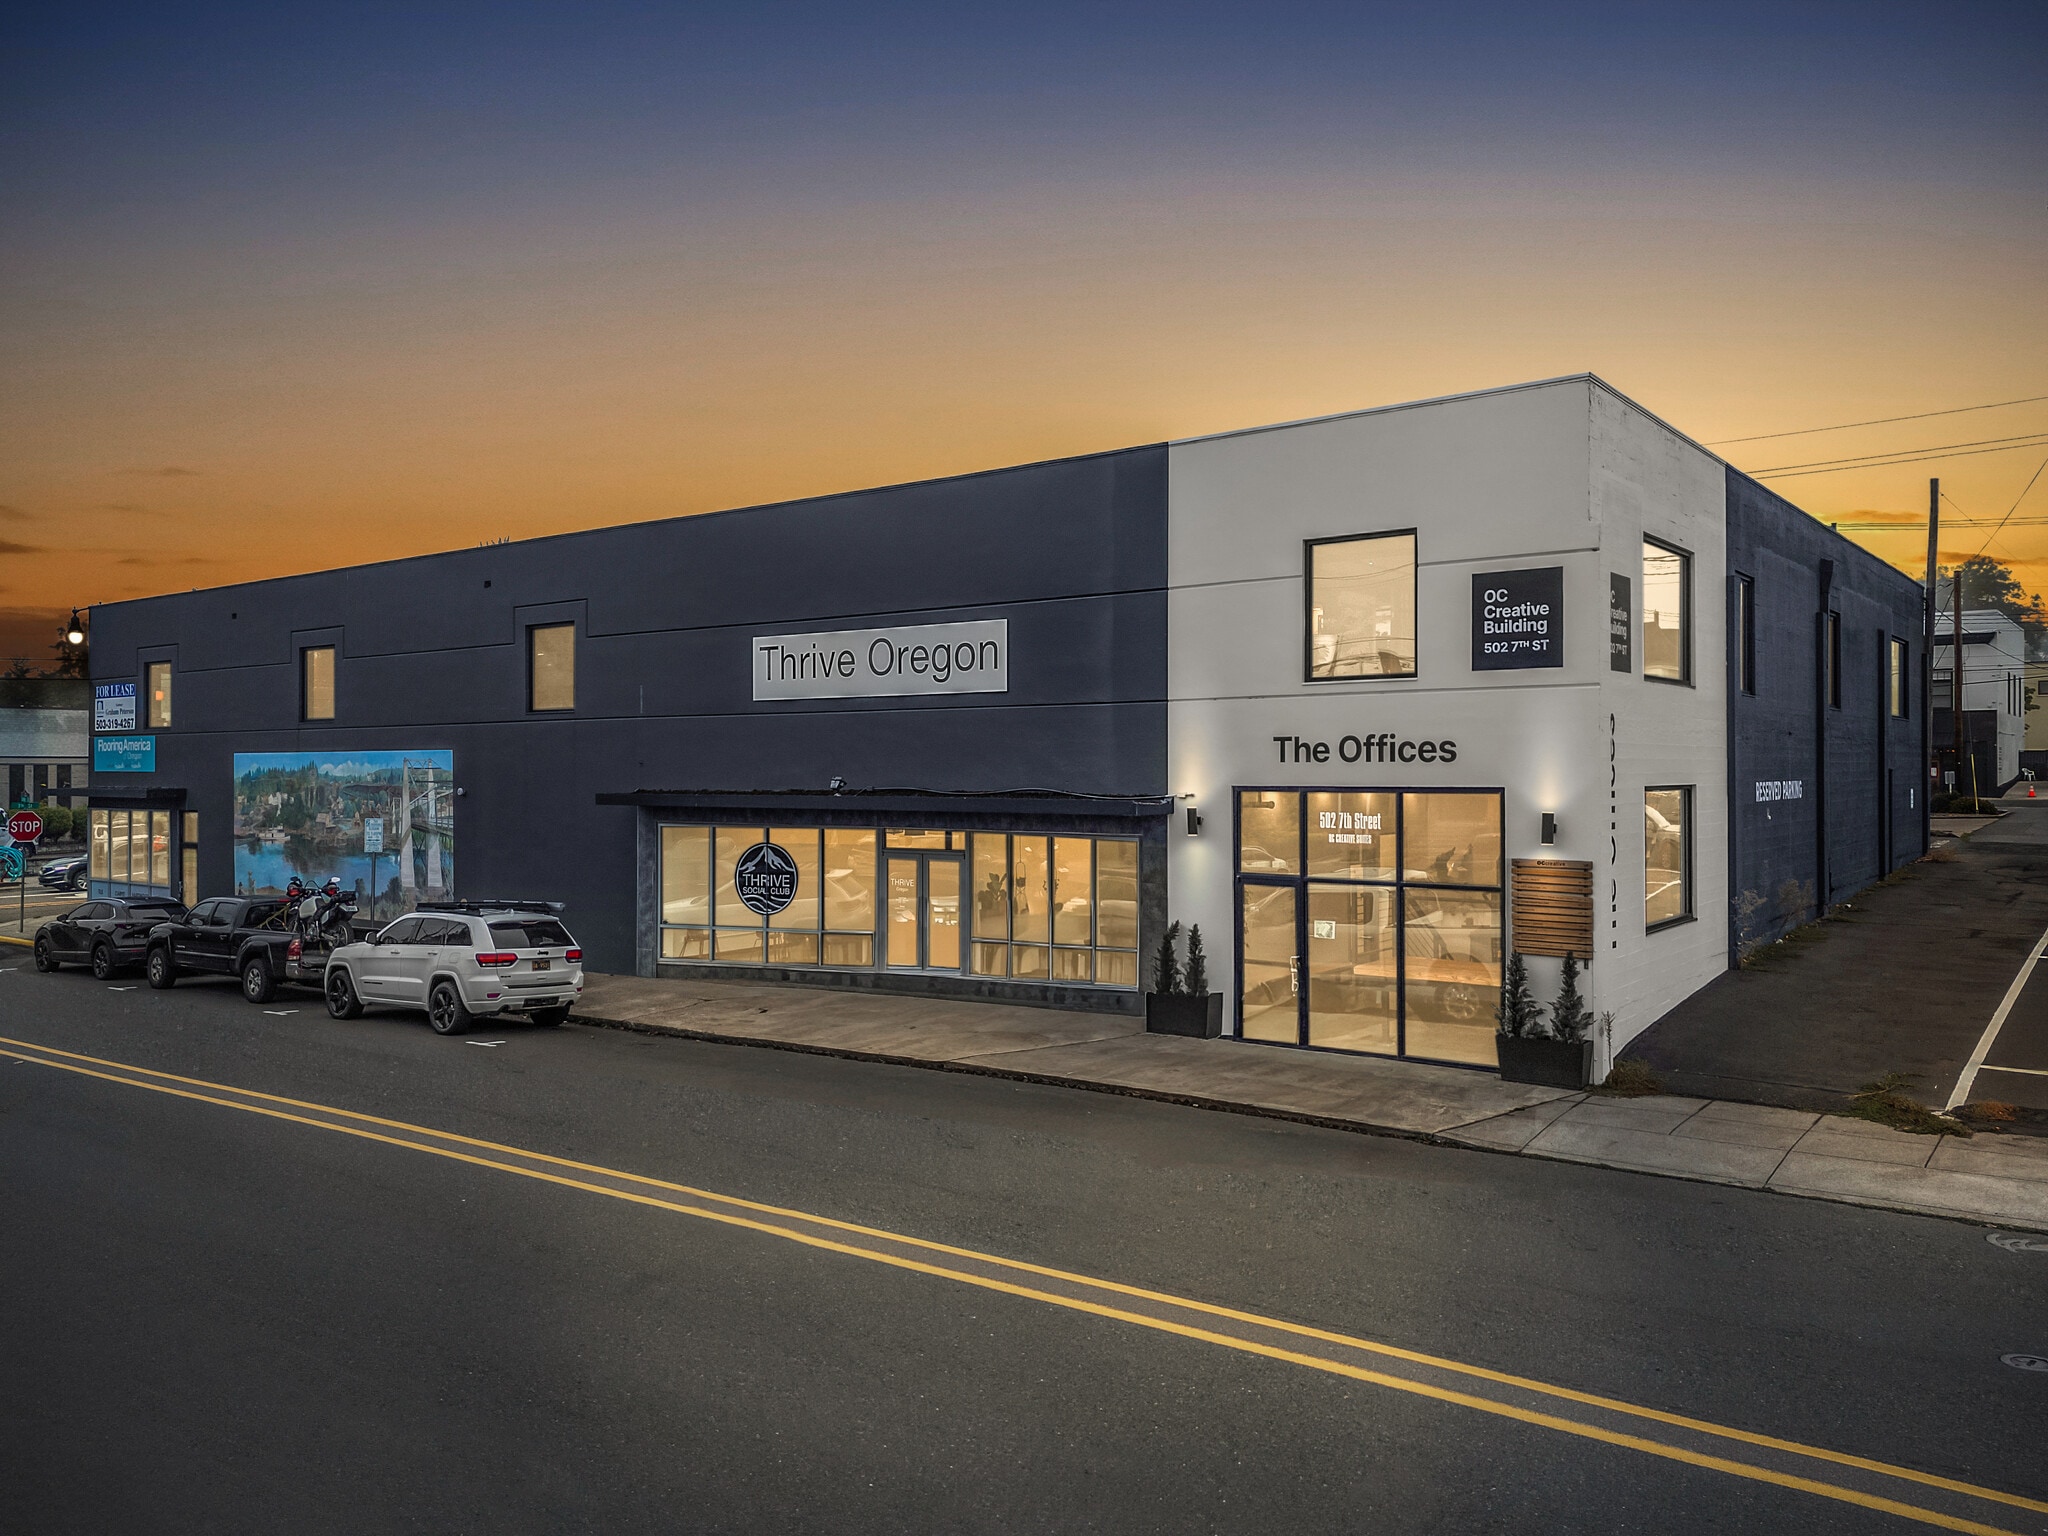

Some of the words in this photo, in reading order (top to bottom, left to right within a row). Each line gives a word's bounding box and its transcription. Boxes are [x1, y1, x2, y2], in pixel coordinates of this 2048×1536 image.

[1483, 588, 1509, 604] OC
[1483, 601, 1550, 619] Creative
[1483, 618, 1548, 635] Building
[1484, 641, 1509, 654] 502
[1511, 640, 1530, 653] 7TH
[1532, 639, 1550, 652] ST
[759, 643, 856, 681] Thrive
[867, 637, 999, 683] Oregon
[96, 685, 110, 698] FOR
[110, 683, 135, 697] LEASE
[1273, 736, 1330, 763] The
[1339, 733, 1458, 763] Offices
[1755, 781, 1782, 803] RESERVED
[1782, 780, 1803, 800] PARKING
[10, 820, 41, 833] STOP
[1319, 812, 1337, 829] 502
[1338, 812, 1352, 829] 7th
[1354, 812, 1382, 830] Street
[742, 874, 791, 887] THRIVE
[890, 878, 915, 887] THRIVE
[742, 886, 769, 895] SOCIAL
[770, 887, 791, 895] CLUB
